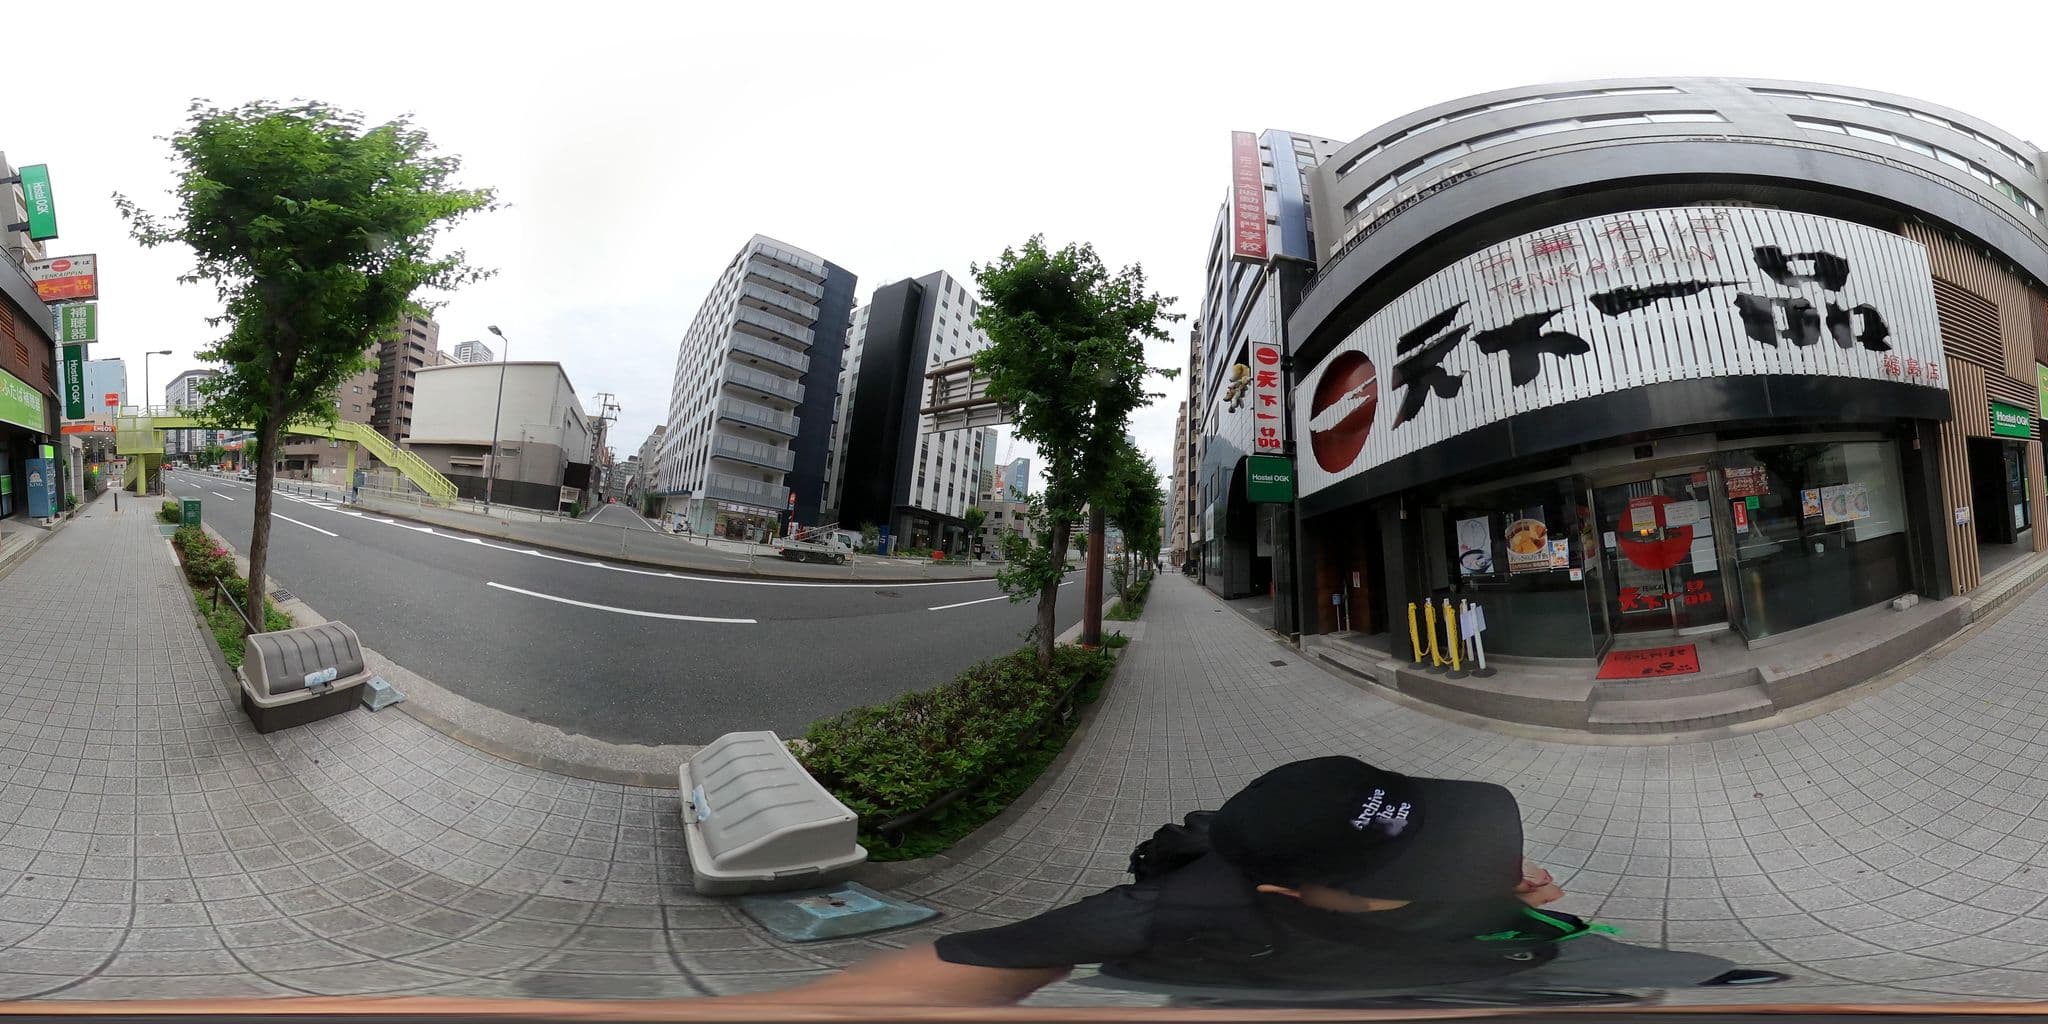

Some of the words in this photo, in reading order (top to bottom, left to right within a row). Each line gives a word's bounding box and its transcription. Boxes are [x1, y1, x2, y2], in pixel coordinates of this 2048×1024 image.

[32, 182, 46, 200] Hostel
[36, 200, 48, 215] OGK
[1489, 245, 1716, 297] TENKAIPPIN
[70, 307, 87, 339] 補聴器
[1392, 245, 1891, 430] 天下一品
[72, 385, 80, 404] OGK
[1256, 370, 1281, 448] 天下一品
[1996, 411, 2016, 423] Hostel
[2016, 415, 2029, 426] OGK
[1252, 473, 1273, 481] Hostel
[1273, 474, 1290, 482] OGK
[1350, 788, 1385, 829] Archive
